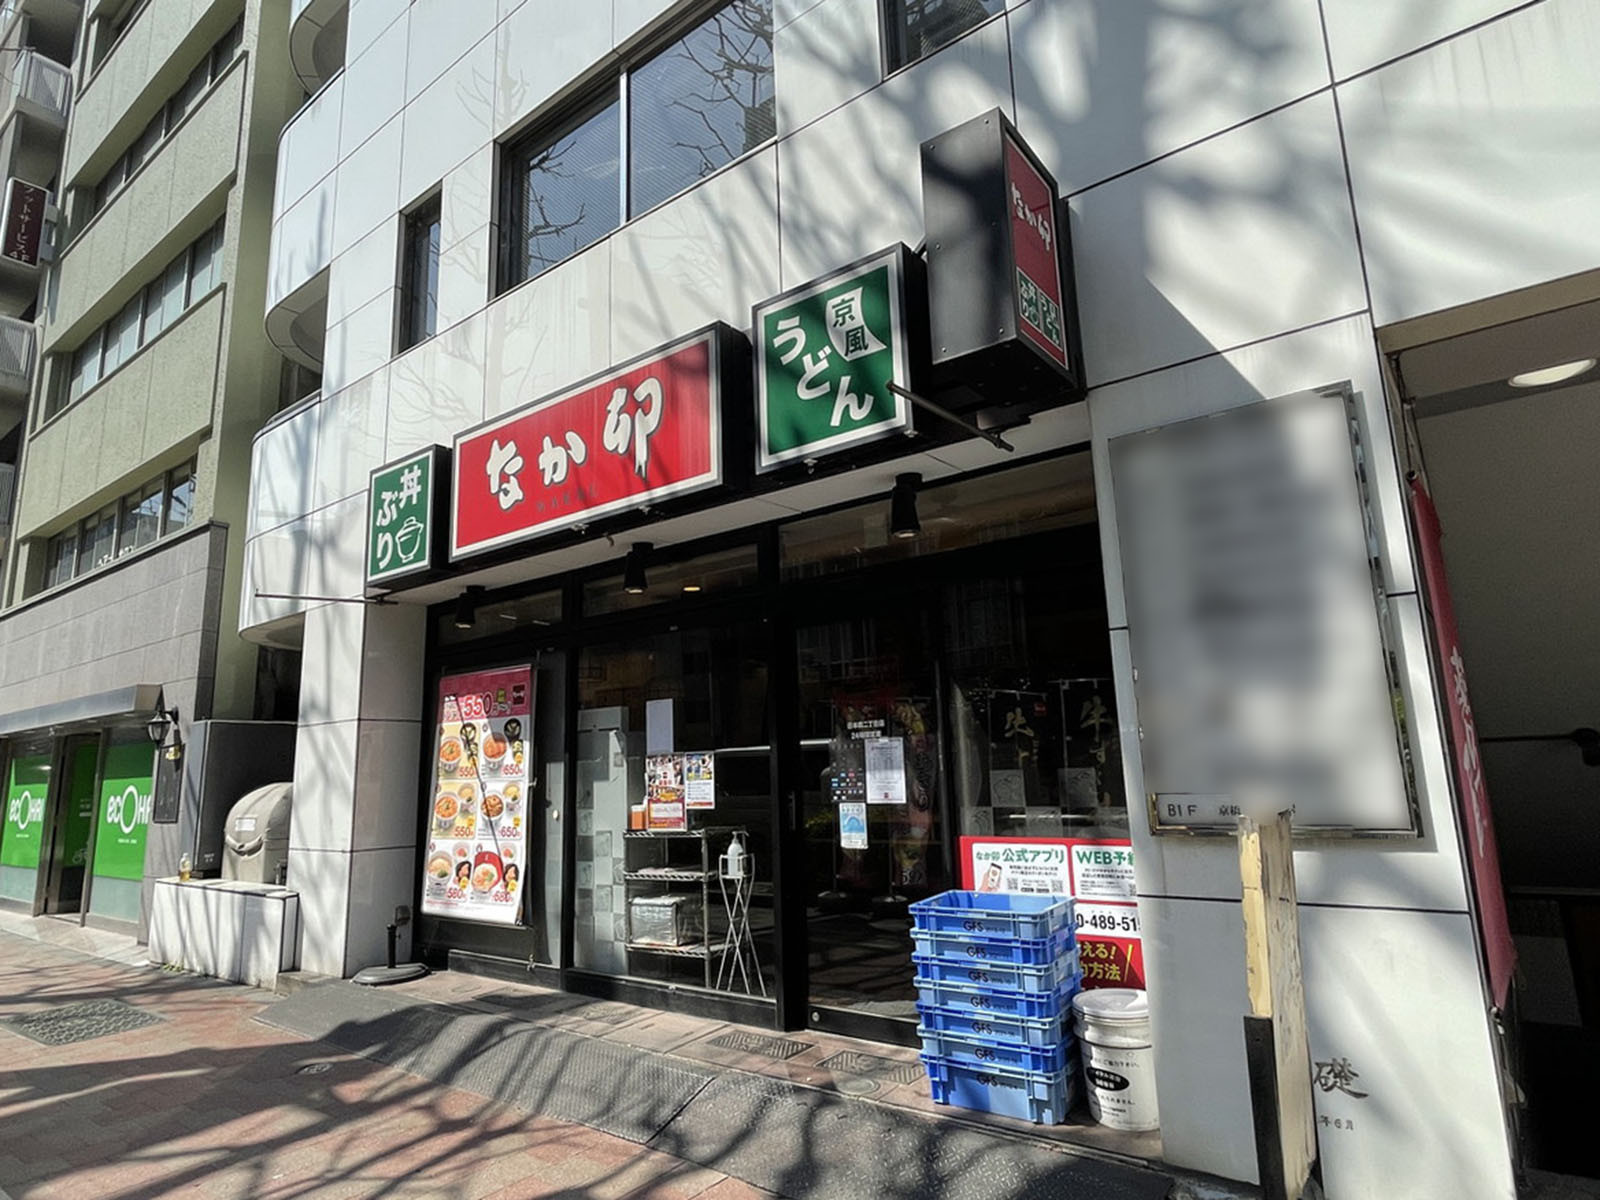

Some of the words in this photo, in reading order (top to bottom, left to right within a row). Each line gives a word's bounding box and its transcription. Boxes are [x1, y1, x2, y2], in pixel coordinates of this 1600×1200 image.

[831, 296, 869, 357] 京風
[773, 316, 874, 427] うどん
[486, 377, 664, 510] なか卯
[1002, 848, 1065, 864] 公式アプリ
[1076, 912, 1141, 932] 0-489-51
